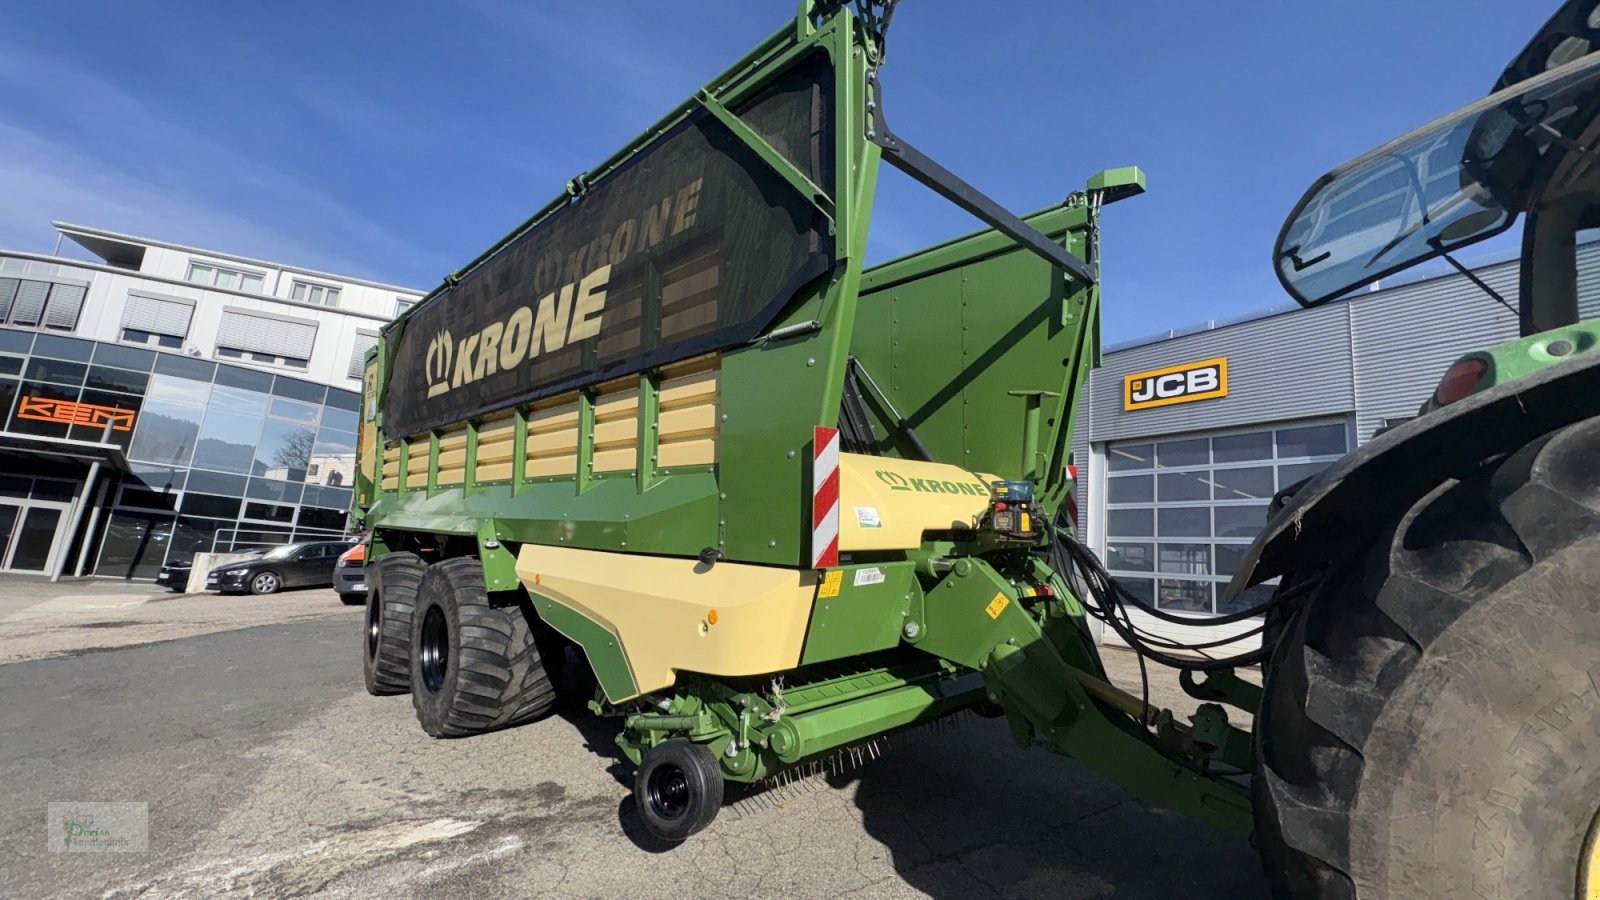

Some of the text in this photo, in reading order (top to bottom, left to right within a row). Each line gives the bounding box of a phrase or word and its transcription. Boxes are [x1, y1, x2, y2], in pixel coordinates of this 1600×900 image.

[452, 264, 612, 390] KRONE
[1132, 367, 1218, 402] JCB
[910, 478, 989, 497] KRONE
